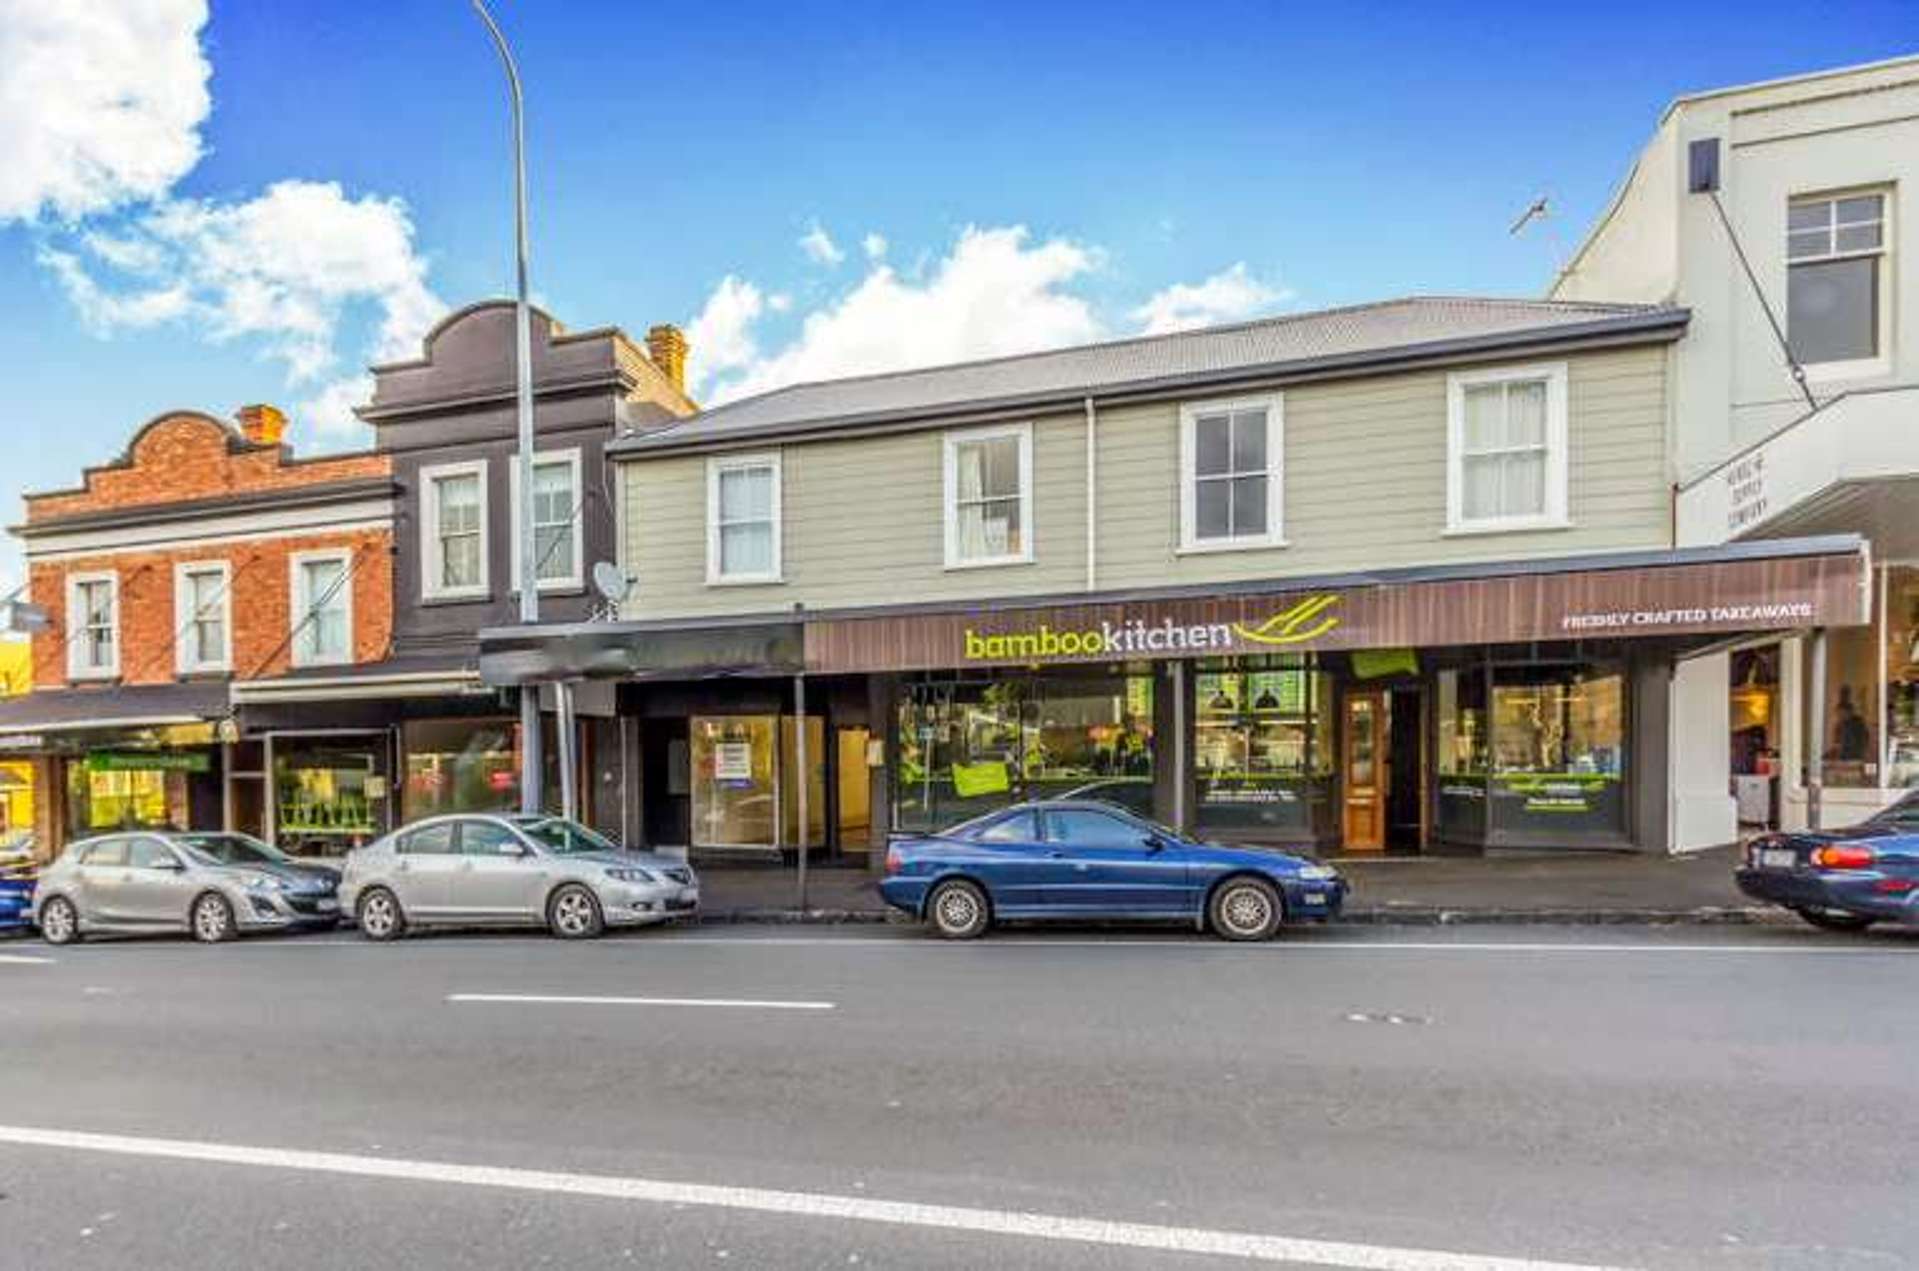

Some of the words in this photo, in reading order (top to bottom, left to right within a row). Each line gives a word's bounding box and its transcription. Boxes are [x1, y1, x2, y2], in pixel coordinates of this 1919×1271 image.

[1563, 611, 1631, 629] FRESHLY
[1632, 606, 1707, 625] CRAFTED
[1711, 601, 1813, 621] TAKEAWAYS
